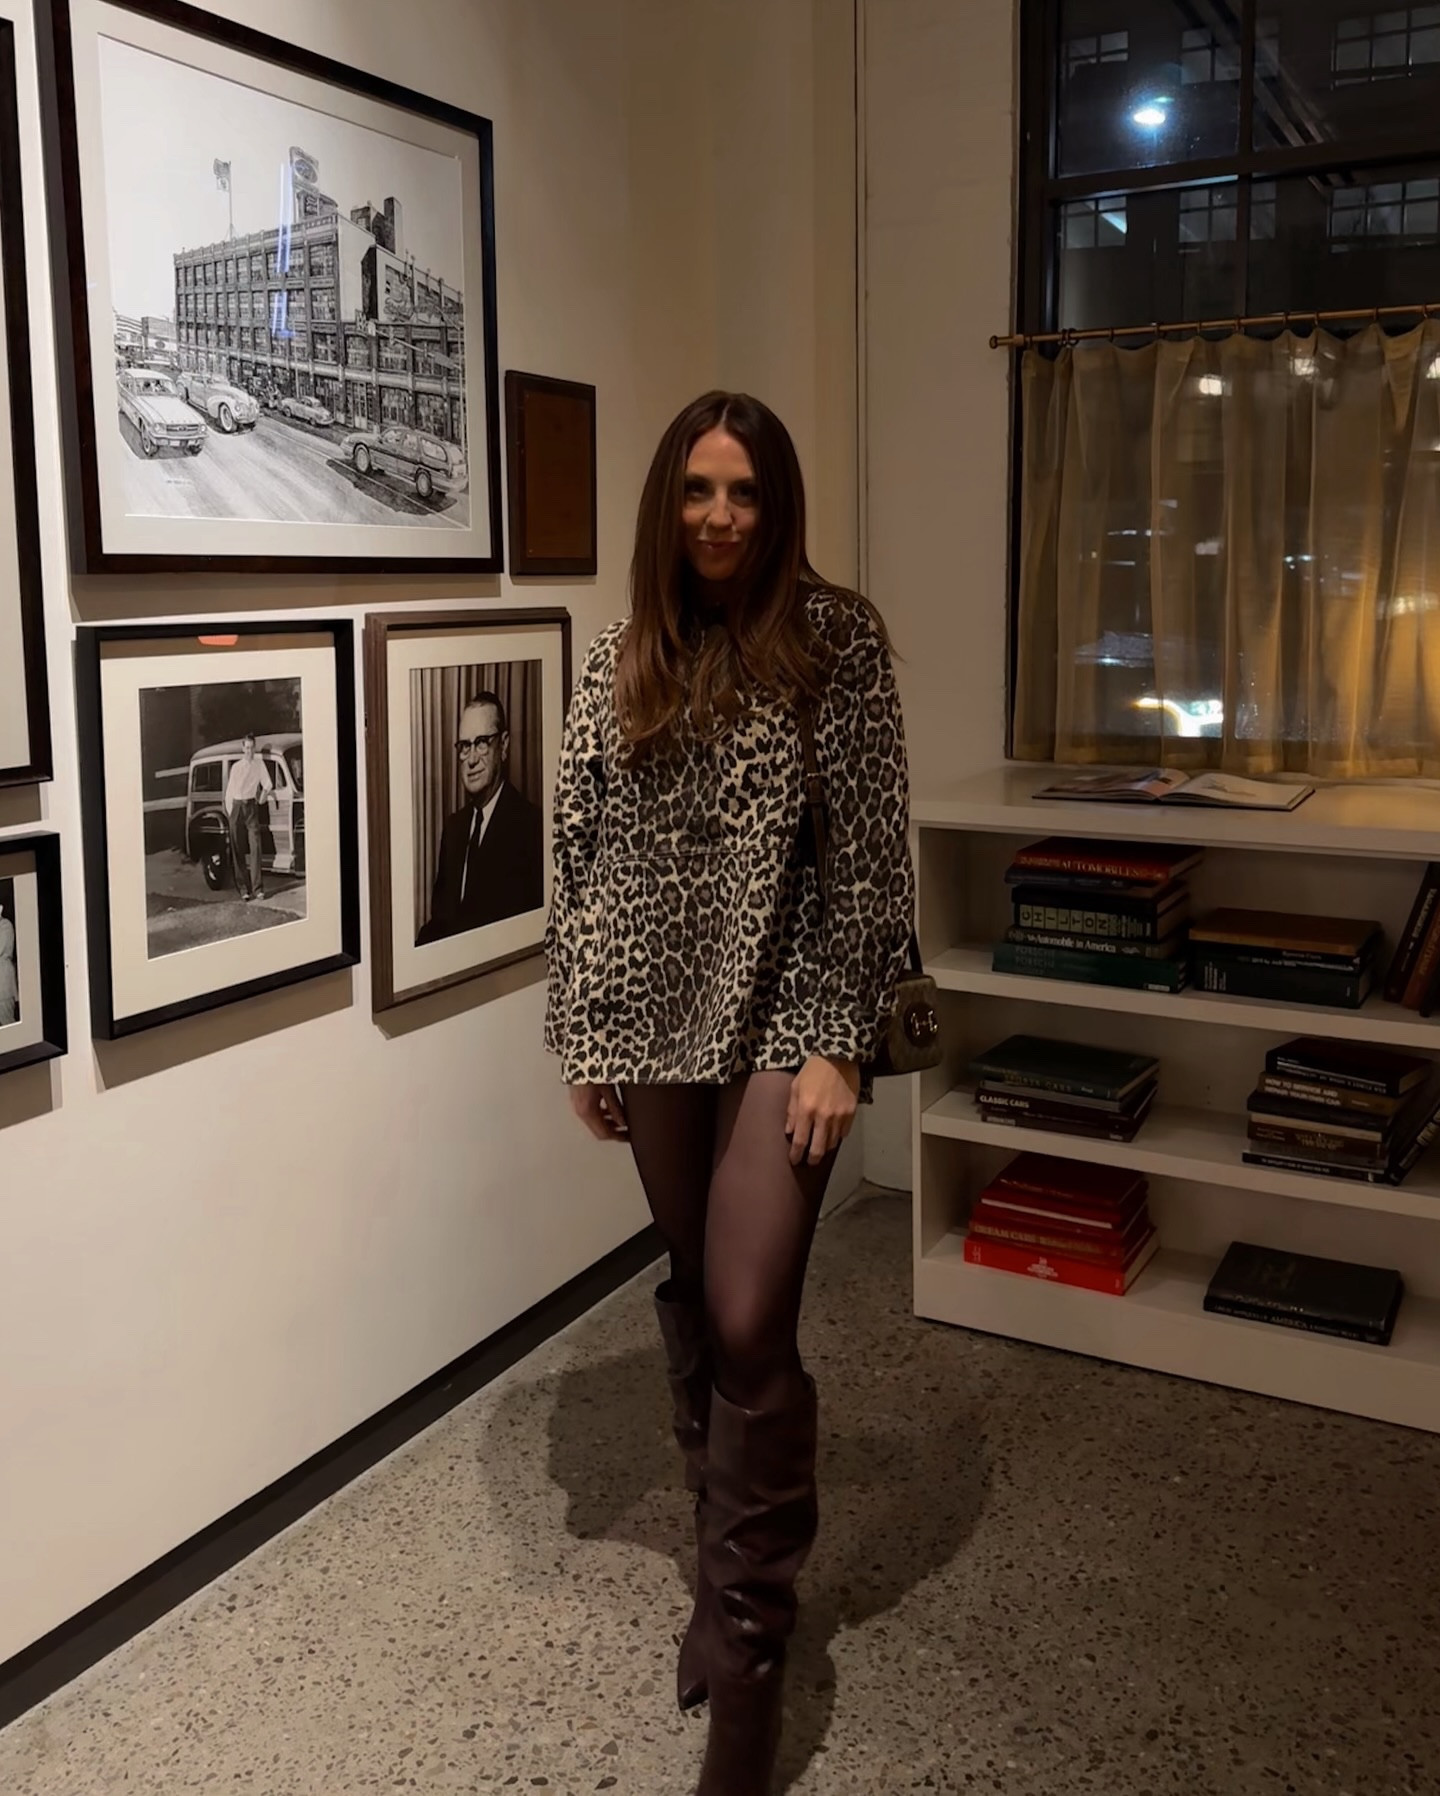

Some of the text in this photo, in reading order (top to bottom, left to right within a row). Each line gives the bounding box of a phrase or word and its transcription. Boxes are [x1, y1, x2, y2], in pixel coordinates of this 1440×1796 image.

[1061, 859, 1140, 877] AUTOMOBILES
[1021, 910, 1108, 930] CHILTON
[1036, 934, 1075, 949] Automobile
[1076, 937, 1085, 949] in
[1085, 939, 1117, 954] America
[1265, 1078, 1281, 1088] HOW
[1322, 1087, 1339, 1098] AND
[979, 1095, 1030, 1109] CLASSIC CARS
